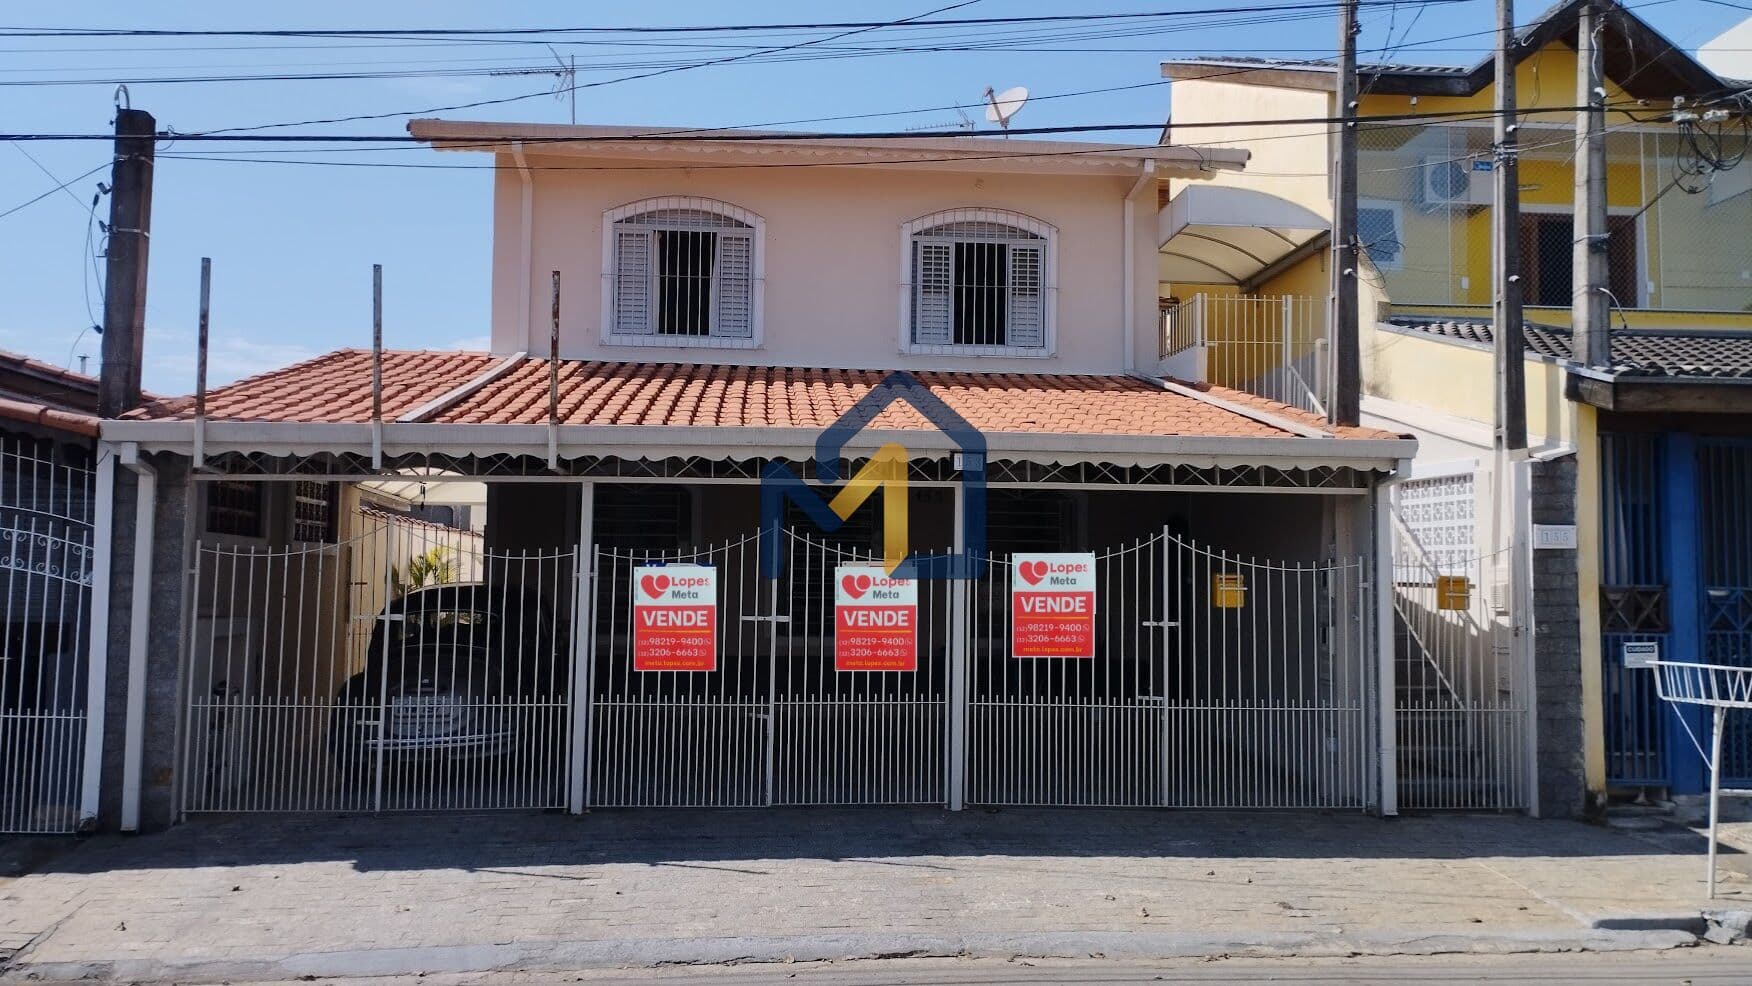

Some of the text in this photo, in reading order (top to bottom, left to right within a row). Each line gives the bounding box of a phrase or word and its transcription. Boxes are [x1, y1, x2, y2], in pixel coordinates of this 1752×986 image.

[1050, 562, 1088, 574] Lopes
[671, 576, 711, 588] Lopes
[872, 577, 911, 588] Lopes
[1050, 576, 1077, 585] Meta
[671, 590, 698, 599] Meta
[872, 590, 900, 599] Meta
[1021, 596, 1087, 613] VENDE
[642, 610, 709, 627] VENDE
[843, 610, 909, 627] VENDE
